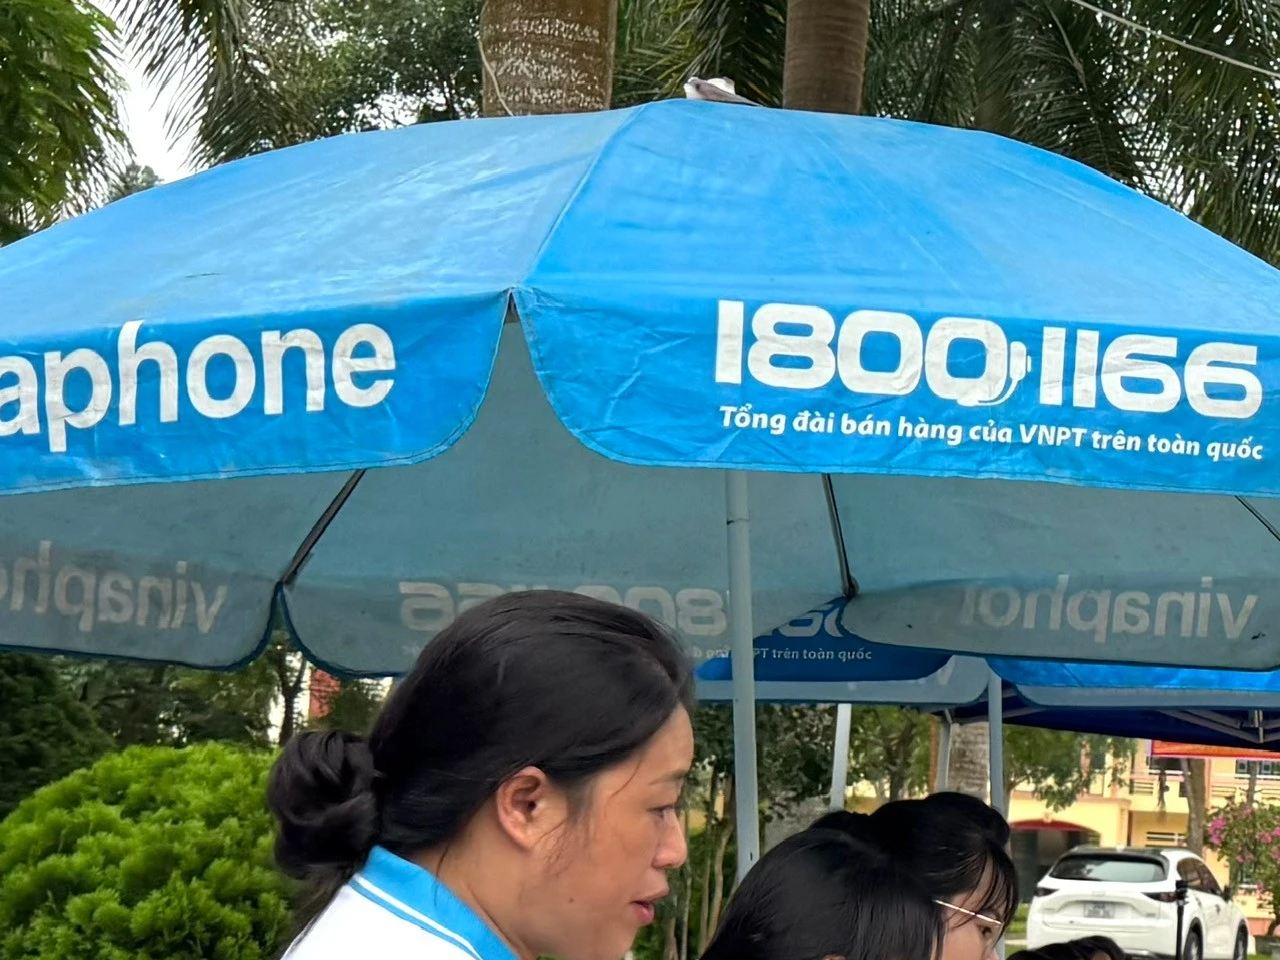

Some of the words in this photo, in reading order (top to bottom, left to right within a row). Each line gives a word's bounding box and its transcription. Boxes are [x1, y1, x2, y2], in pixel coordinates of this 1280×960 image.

[719, 403, 786, 436] Tổng
[792, 410, 835, 433] đài
[841, 413, 891, 436] bán
[898, 415, 962, 446] hàng
[968, 418, 1013, 444] của
[1019, 423, 1088, 447] VNPT
[1091, 429, 1141, 451] trên
[1148, 432, 1200, 456] toàn
[1206, 435, 1264, 462] quốc
[772, 647, 799, 660] trên
[803, 647, 835, 660] toàn
[837, 646, 873, 663] quốc
